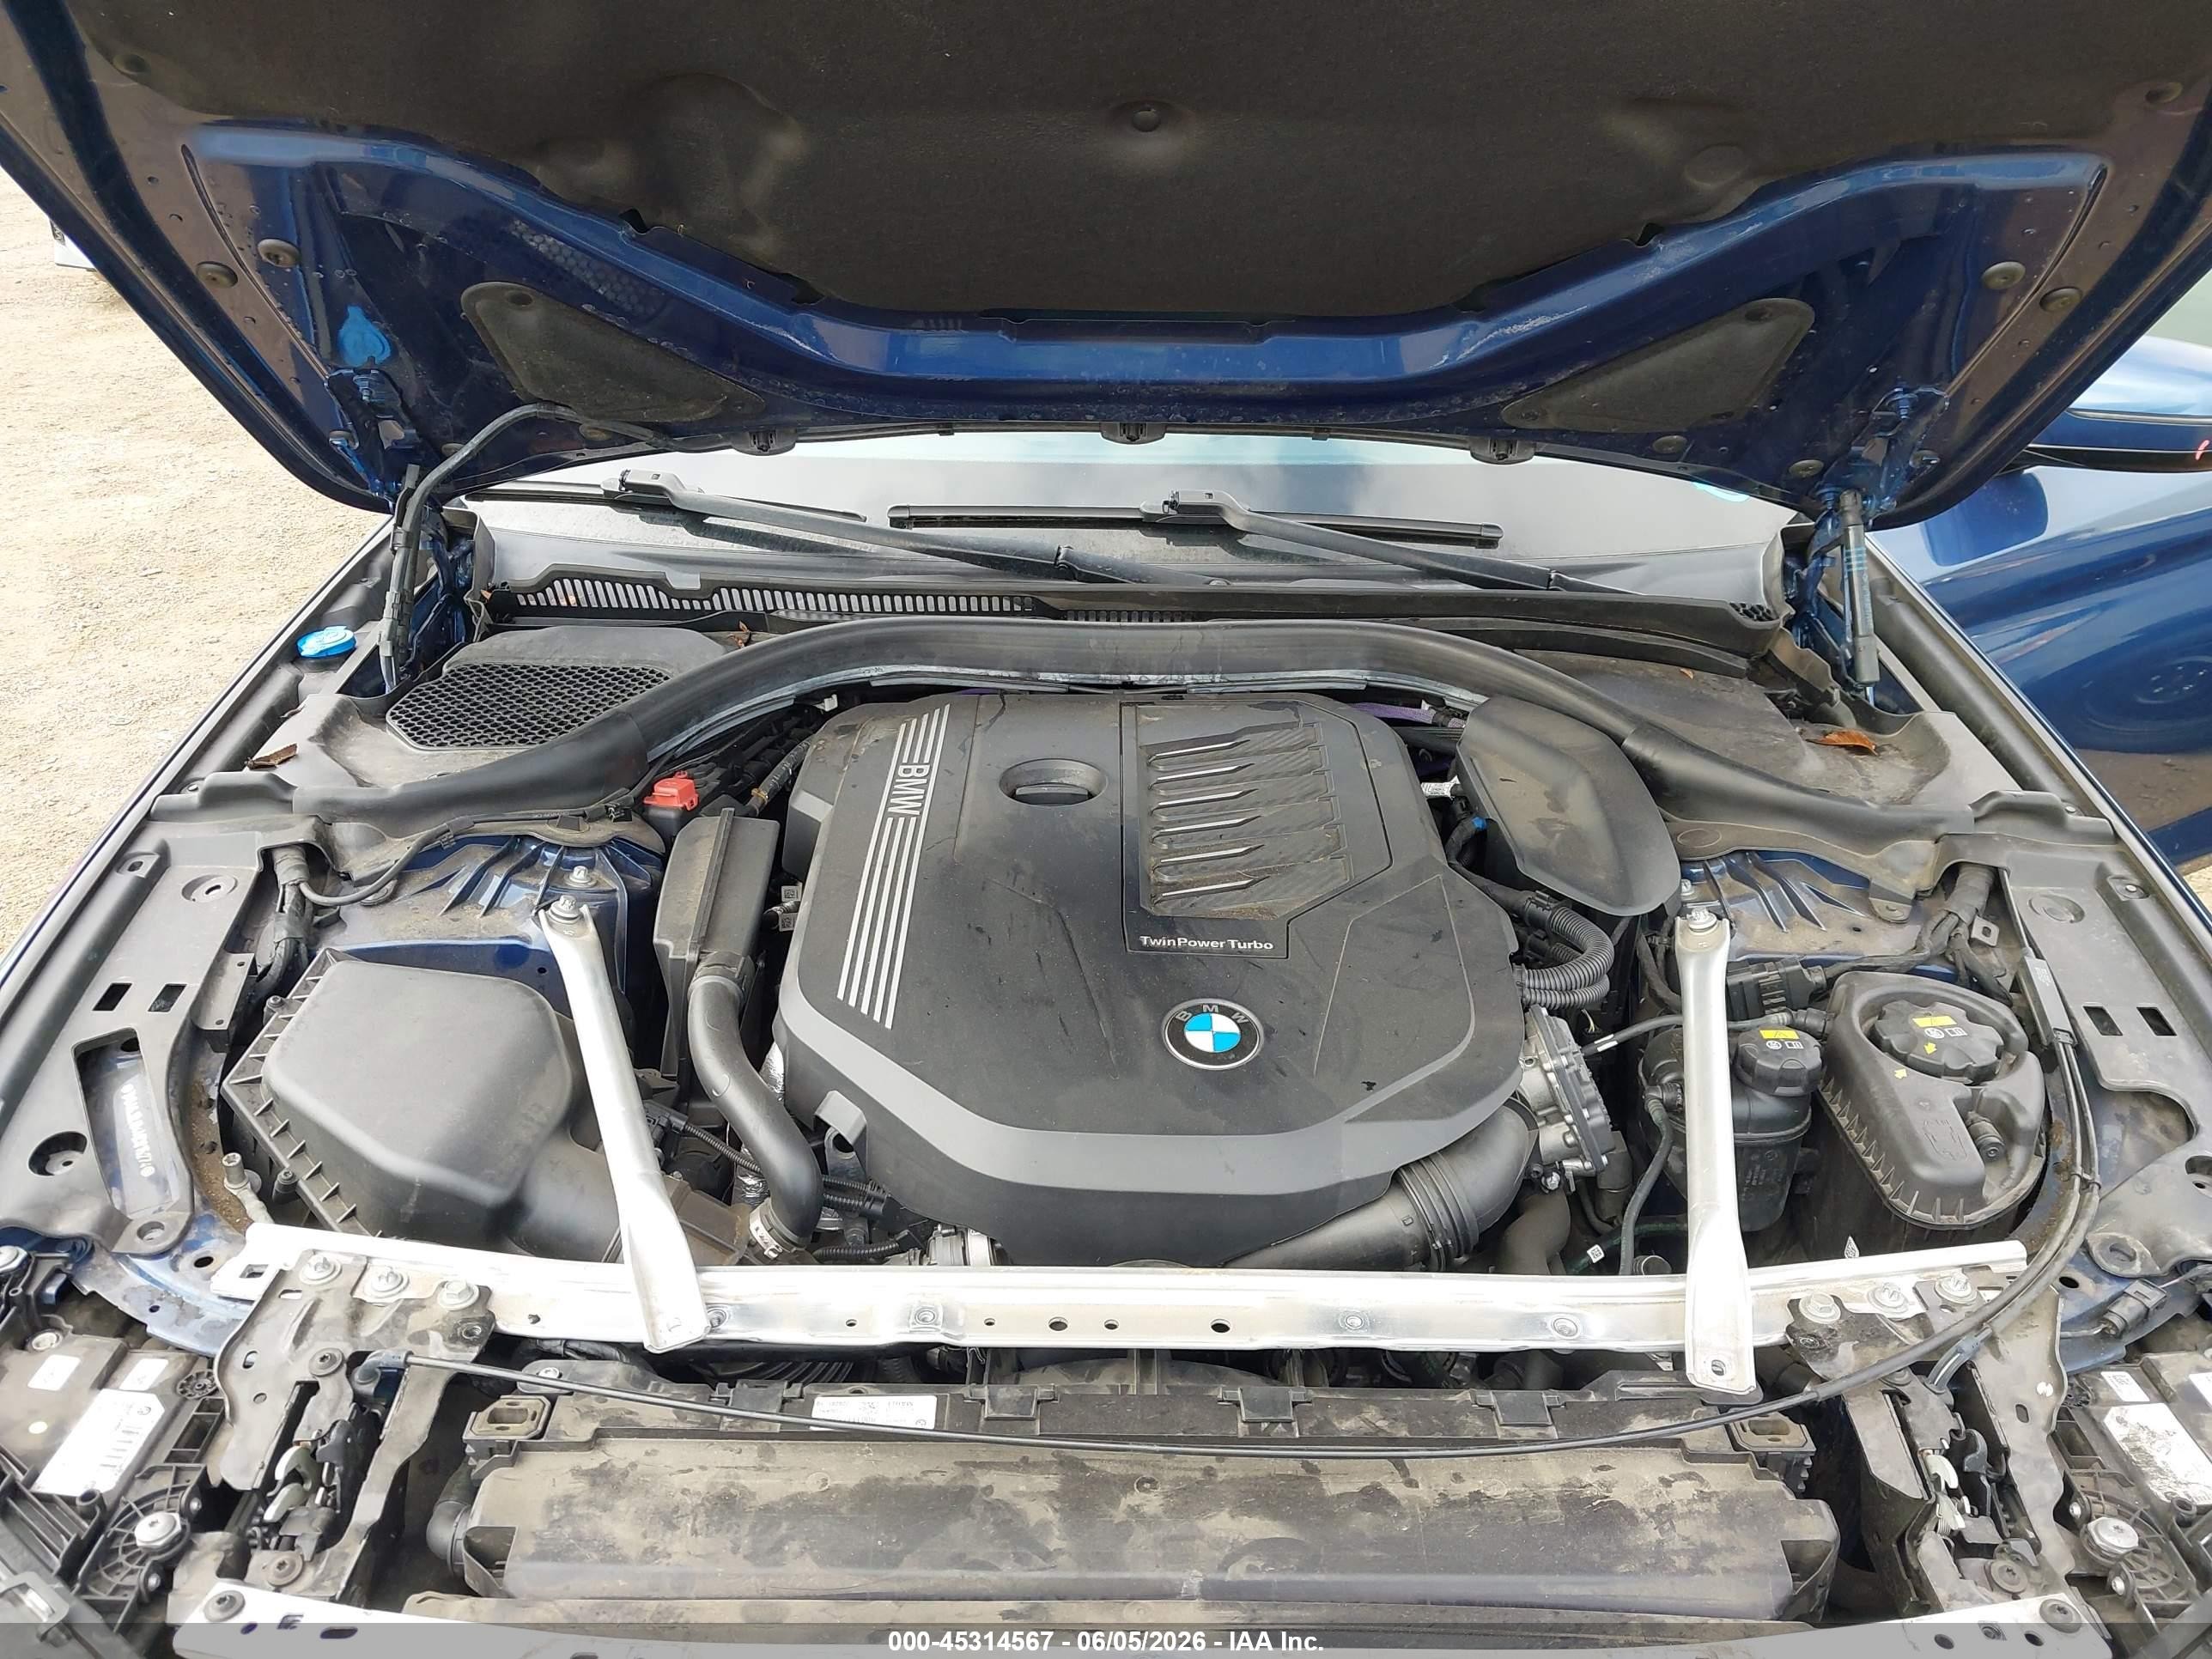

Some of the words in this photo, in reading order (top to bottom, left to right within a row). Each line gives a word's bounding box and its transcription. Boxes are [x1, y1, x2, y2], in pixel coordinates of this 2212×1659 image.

[888, 765, 930, 815] BMW
[1139, 935, 1226, 948] TwinPower
[1227, 939, 1274, 950] Turbo
[1175, 1004, 1249, 1024] BMW
